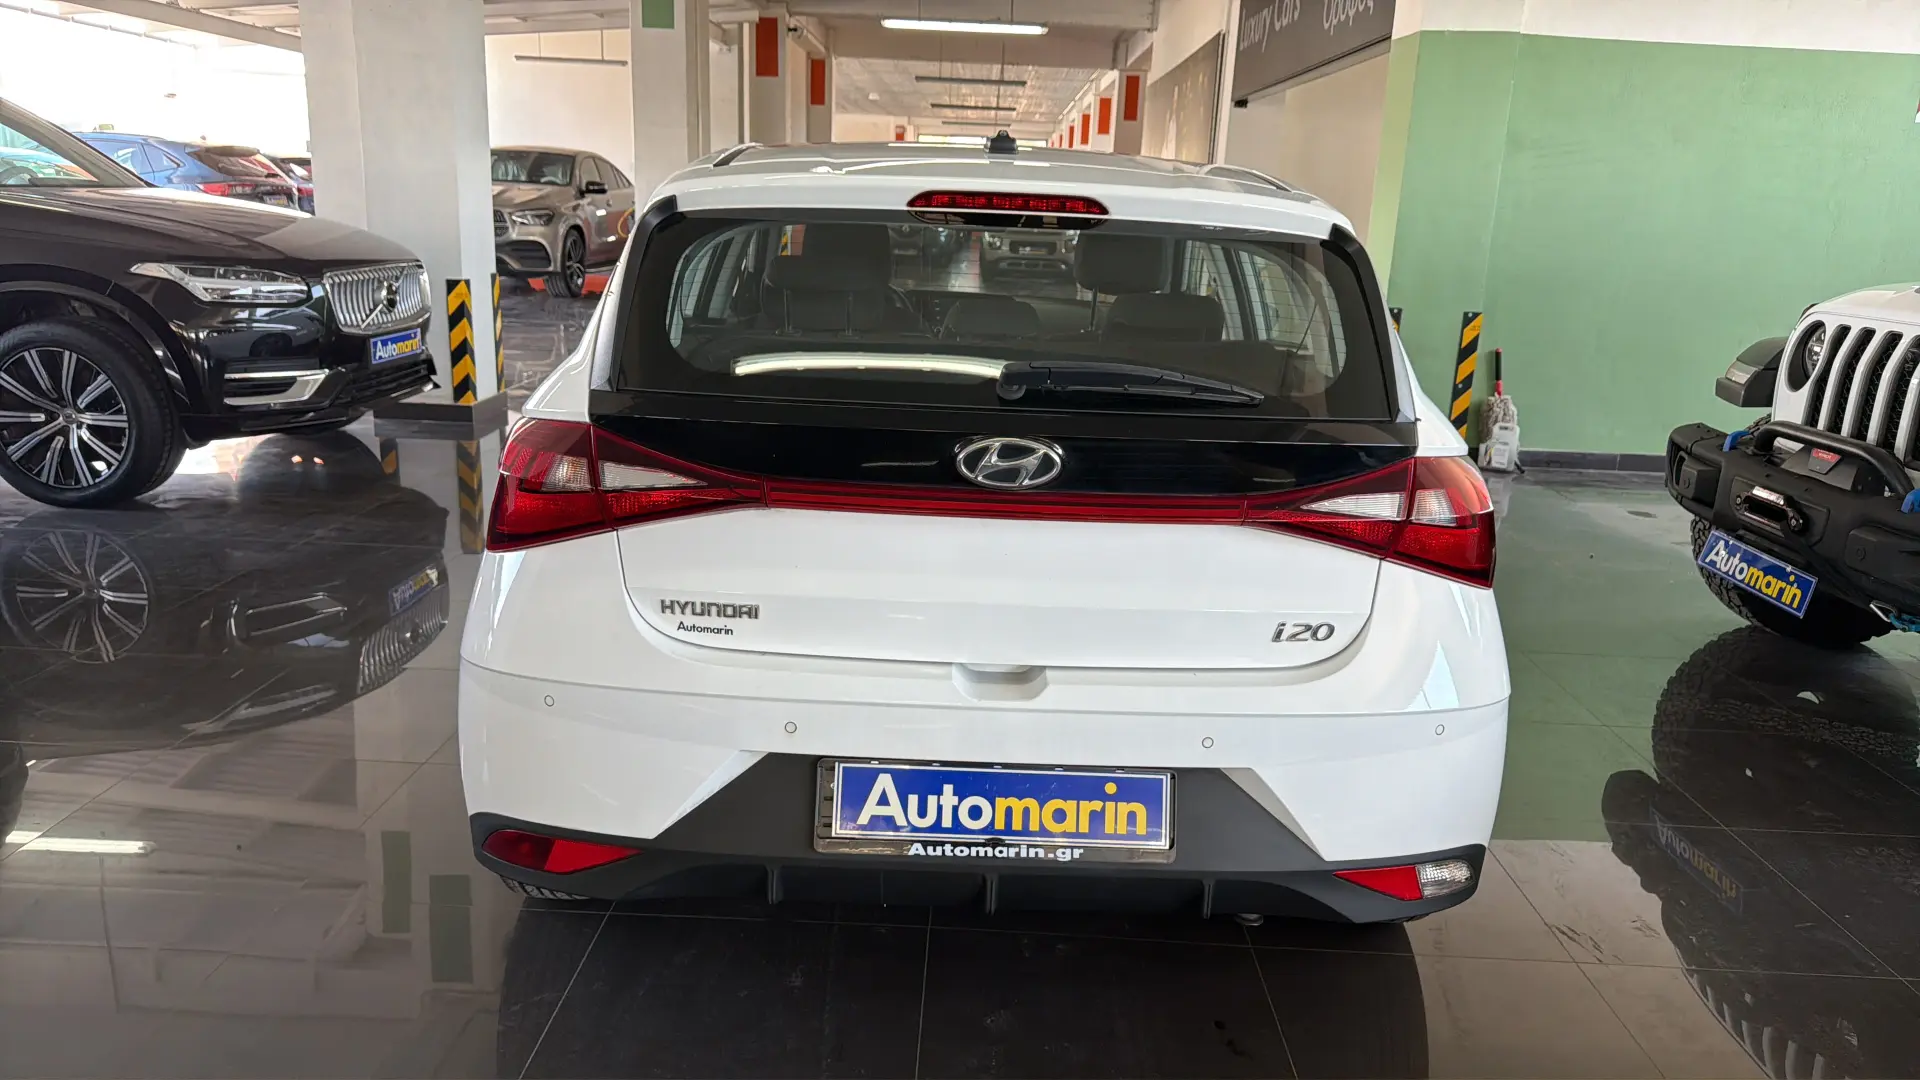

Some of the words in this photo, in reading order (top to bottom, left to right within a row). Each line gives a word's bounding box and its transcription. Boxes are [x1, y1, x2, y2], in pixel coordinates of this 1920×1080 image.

[1239, 5, 1273, 53] Luxury
[1274, 0, 1300, 32] Cars
[375, 334, 420, 360] Automarin
[1704, 539, 1803, 609] Automarin
[660, 599, 760, 620] HYUNDAI
[677, 620, 734, 636] Automarin
[1271, 620, 1336, 643] i20
[856, 773, 1147, 836] Automarin
[908, 842, 1084, 862] Automarin.gr
